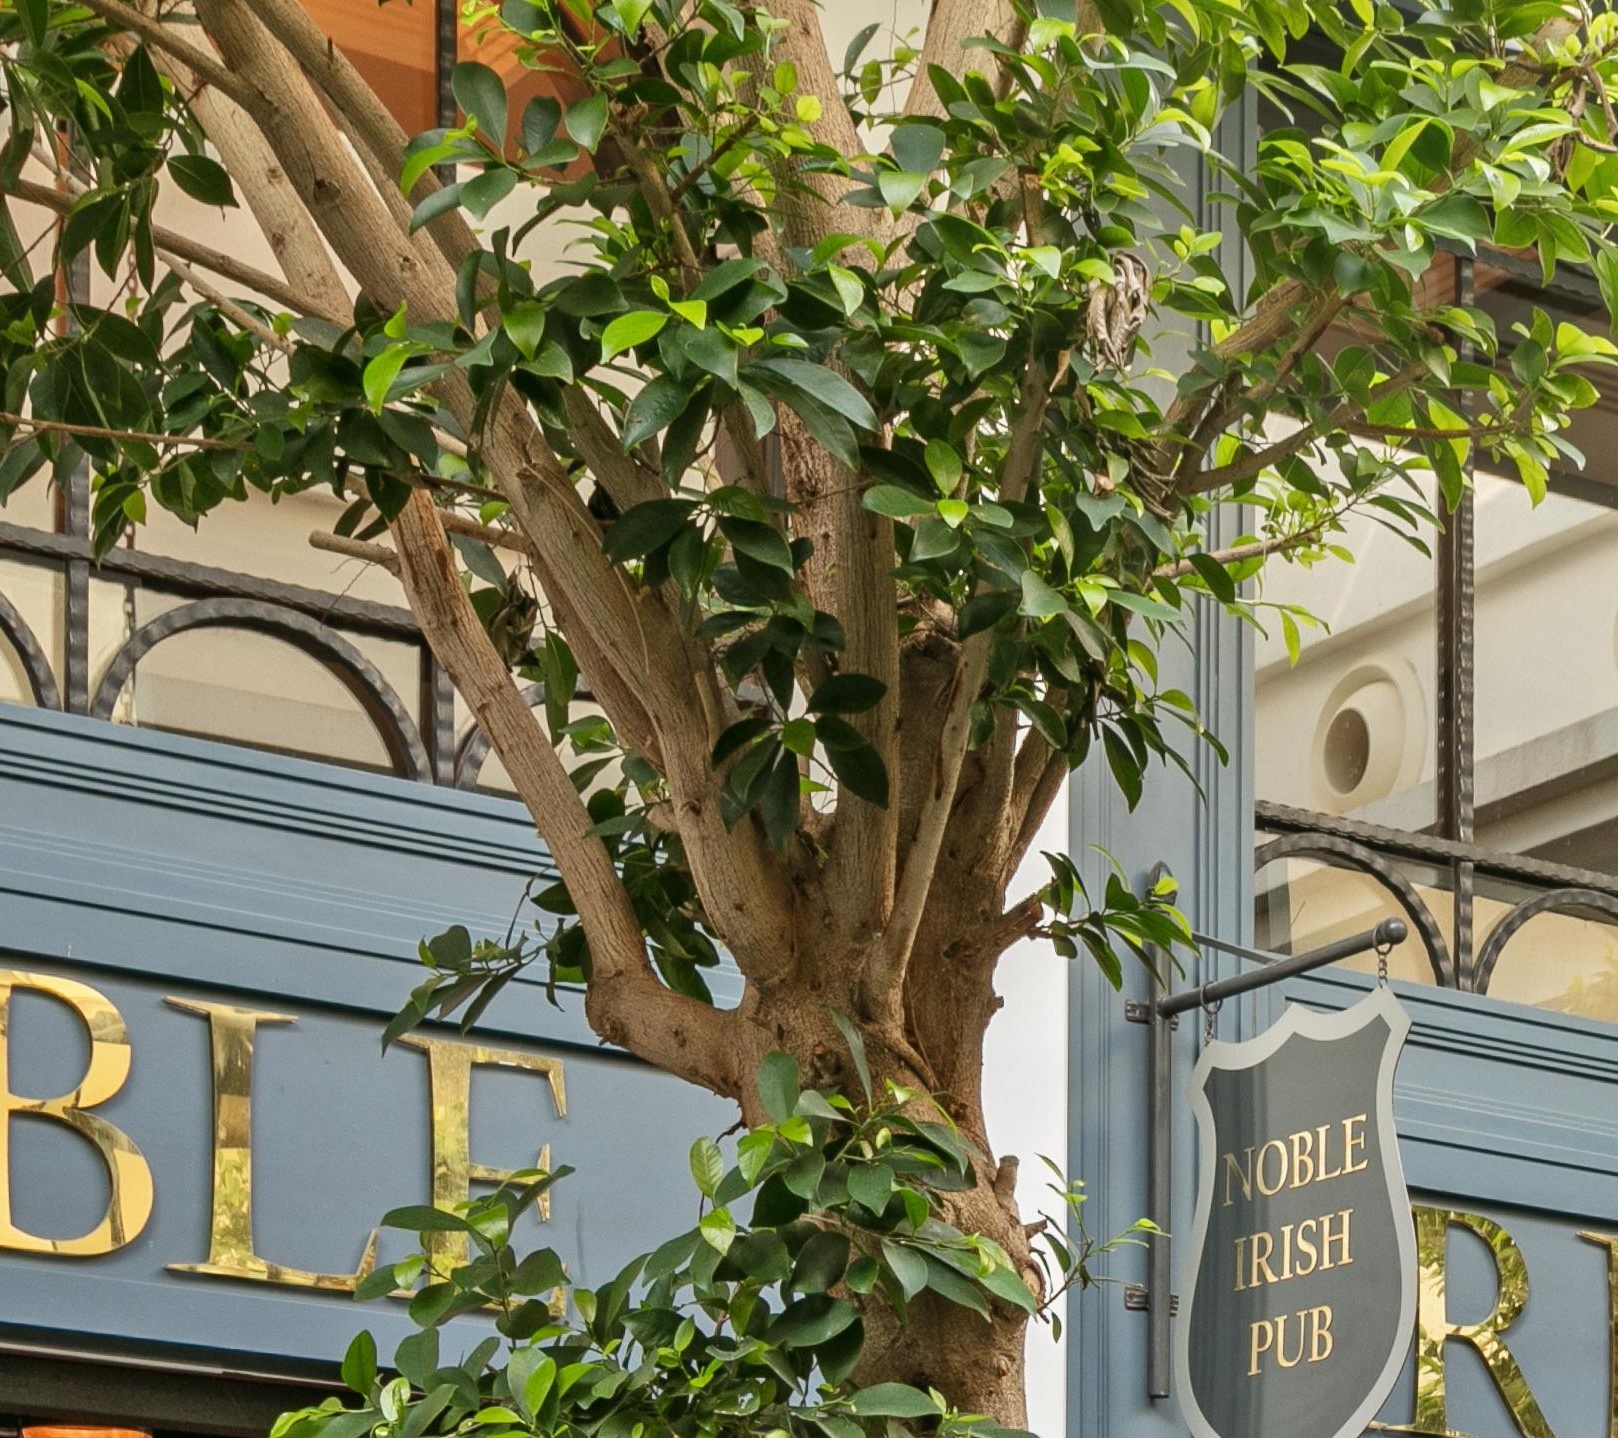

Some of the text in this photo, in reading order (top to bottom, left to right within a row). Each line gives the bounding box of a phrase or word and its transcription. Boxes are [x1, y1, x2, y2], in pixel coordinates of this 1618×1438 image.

[1222, 1113, 1370, 1208] NOBLE
[1234, 1208, 1355, 1294] IRISH
[1246, 1304, 1335, 1378] PUB
